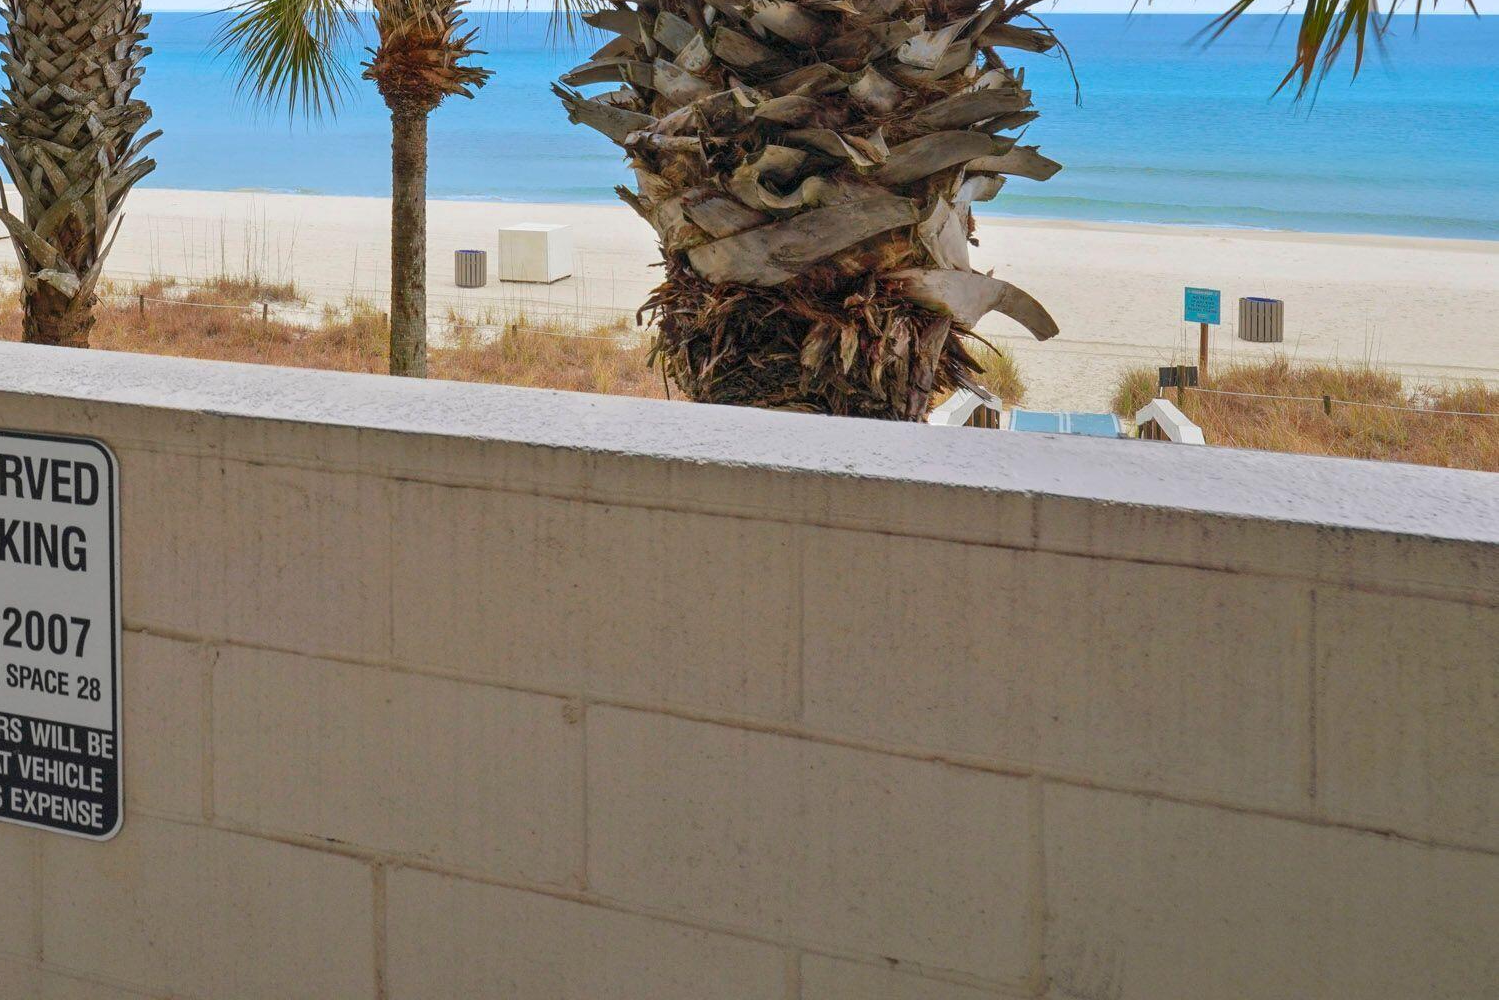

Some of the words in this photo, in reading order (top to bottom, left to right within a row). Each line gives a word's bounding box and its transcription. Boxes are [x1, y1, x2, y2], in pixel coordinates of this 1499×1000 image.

[3, 607, 90, 657] 2007
[6, 664, 69, 696] SPACE
[77, 676, 100, 701] 28
[30, 722, 80, 754] WILL
[88, 731, 112, 759] BE
[18, 754, 102, 792] VEHICLE
[11, 787, 102, 828] EXPENSE
